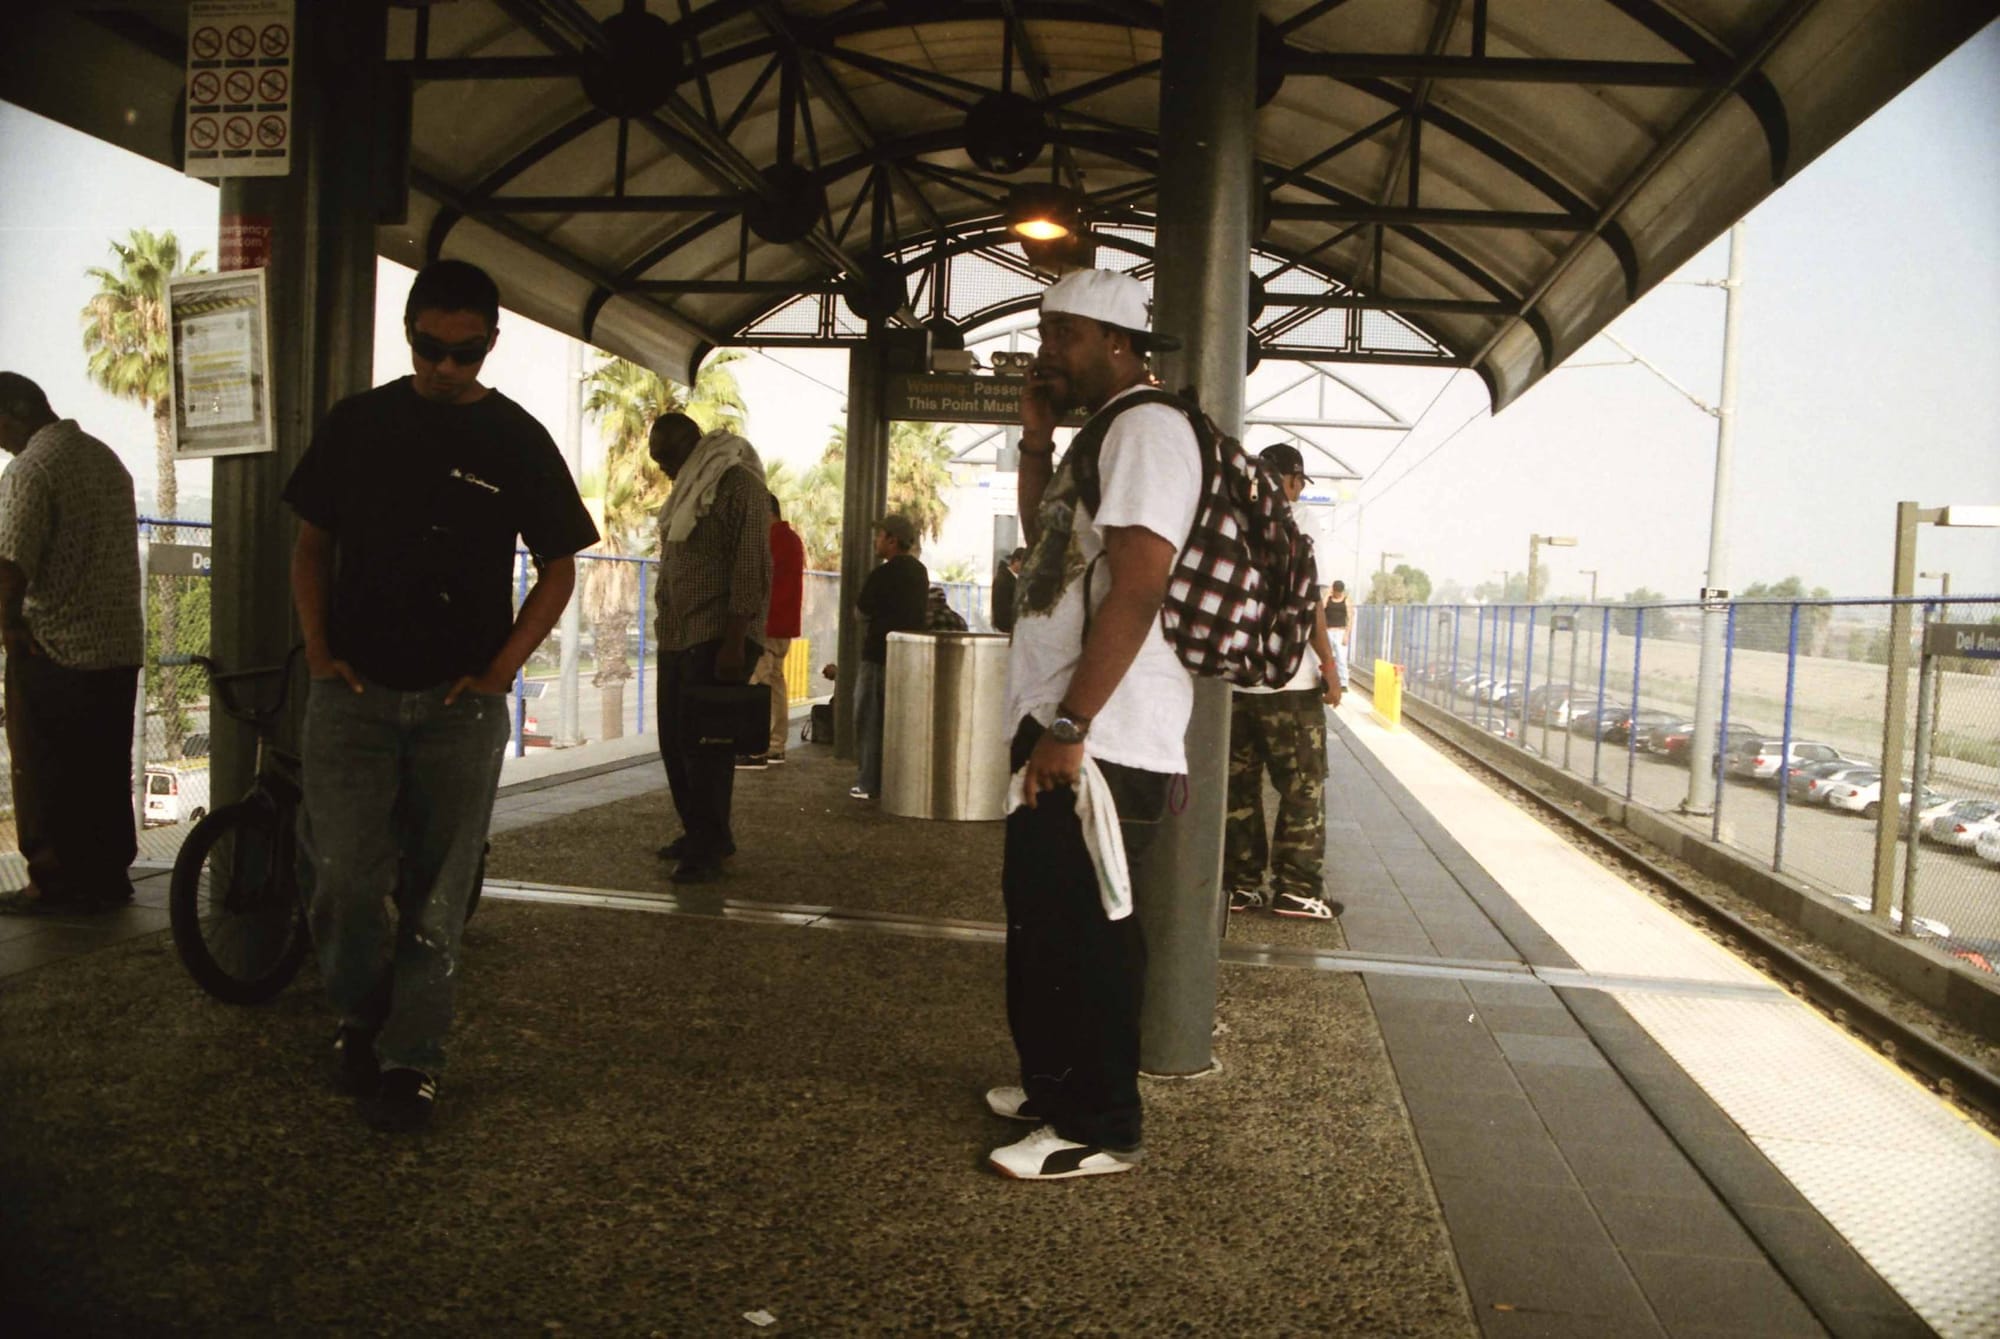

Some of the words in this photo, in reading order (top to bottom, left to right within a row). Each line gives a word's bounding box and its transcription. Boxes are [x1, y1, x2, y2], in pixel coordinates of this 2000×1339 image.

[907, 397, 937, 410] This
[941, 397, 979, 411] Point
[983, 399, 1019, 413] Must
[1956, 631, 1975, 650] Del
